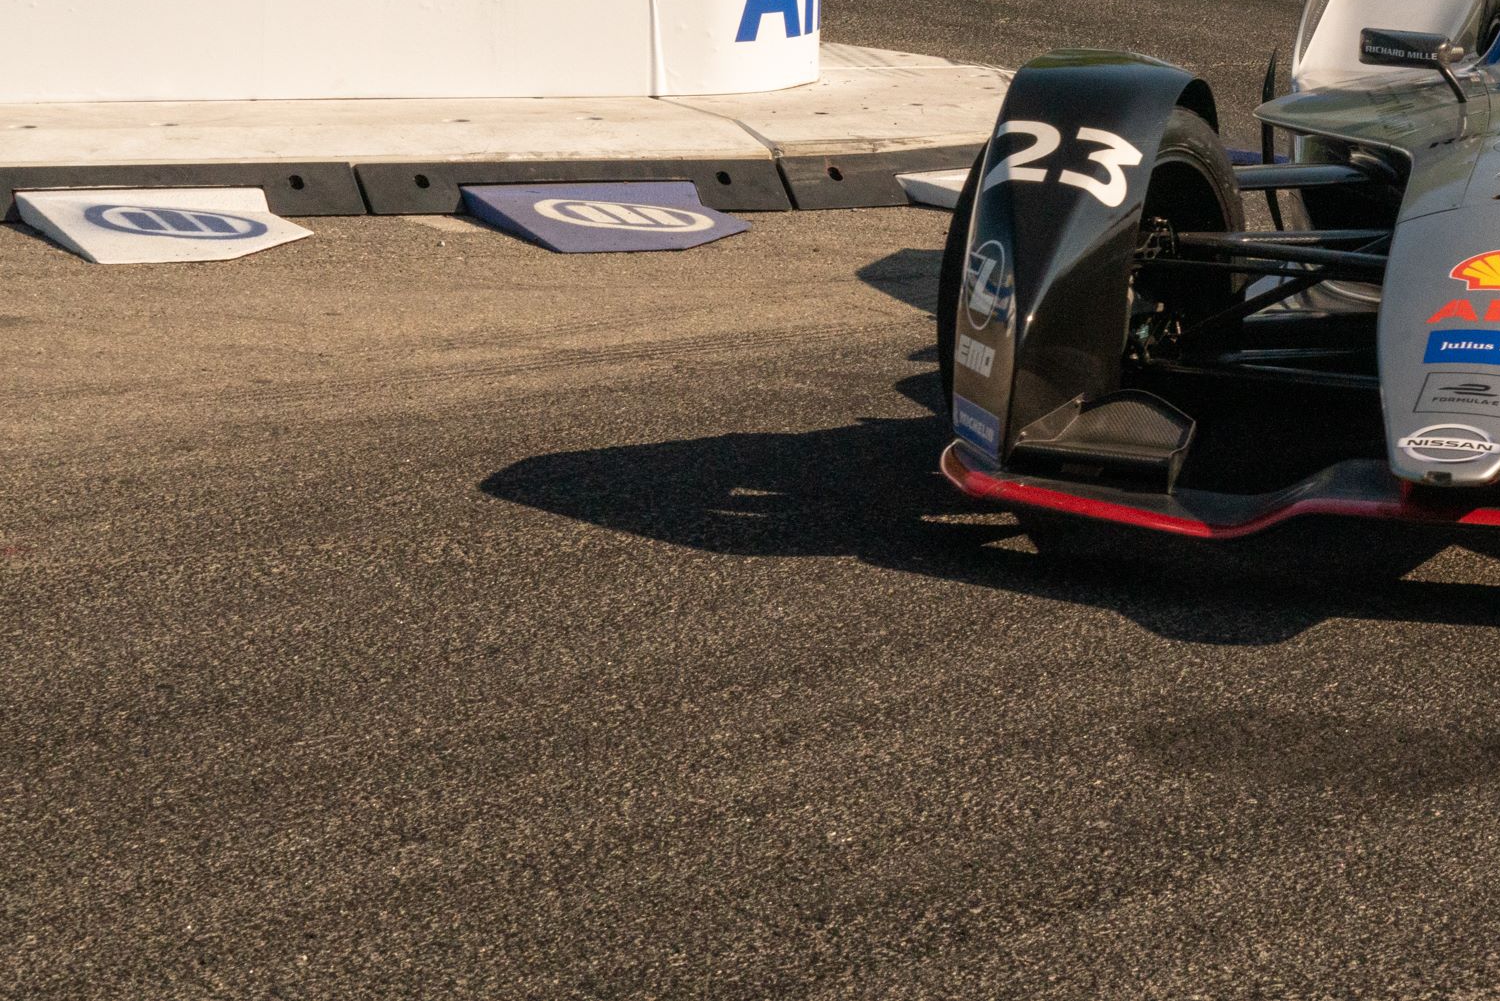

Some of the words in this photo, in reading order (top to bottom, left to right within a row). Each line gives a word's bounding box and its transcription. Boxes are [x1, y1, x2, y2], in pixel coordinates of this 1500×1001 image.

[1365, 45, 1405, 57] RICHARD
[1407, 51, 1438, 60] MILLE
[983, 120, 1143, 207] 23
[1440, 341, 1494, 351] Julius
[1407, 439, 1493, 451] NISSAN
